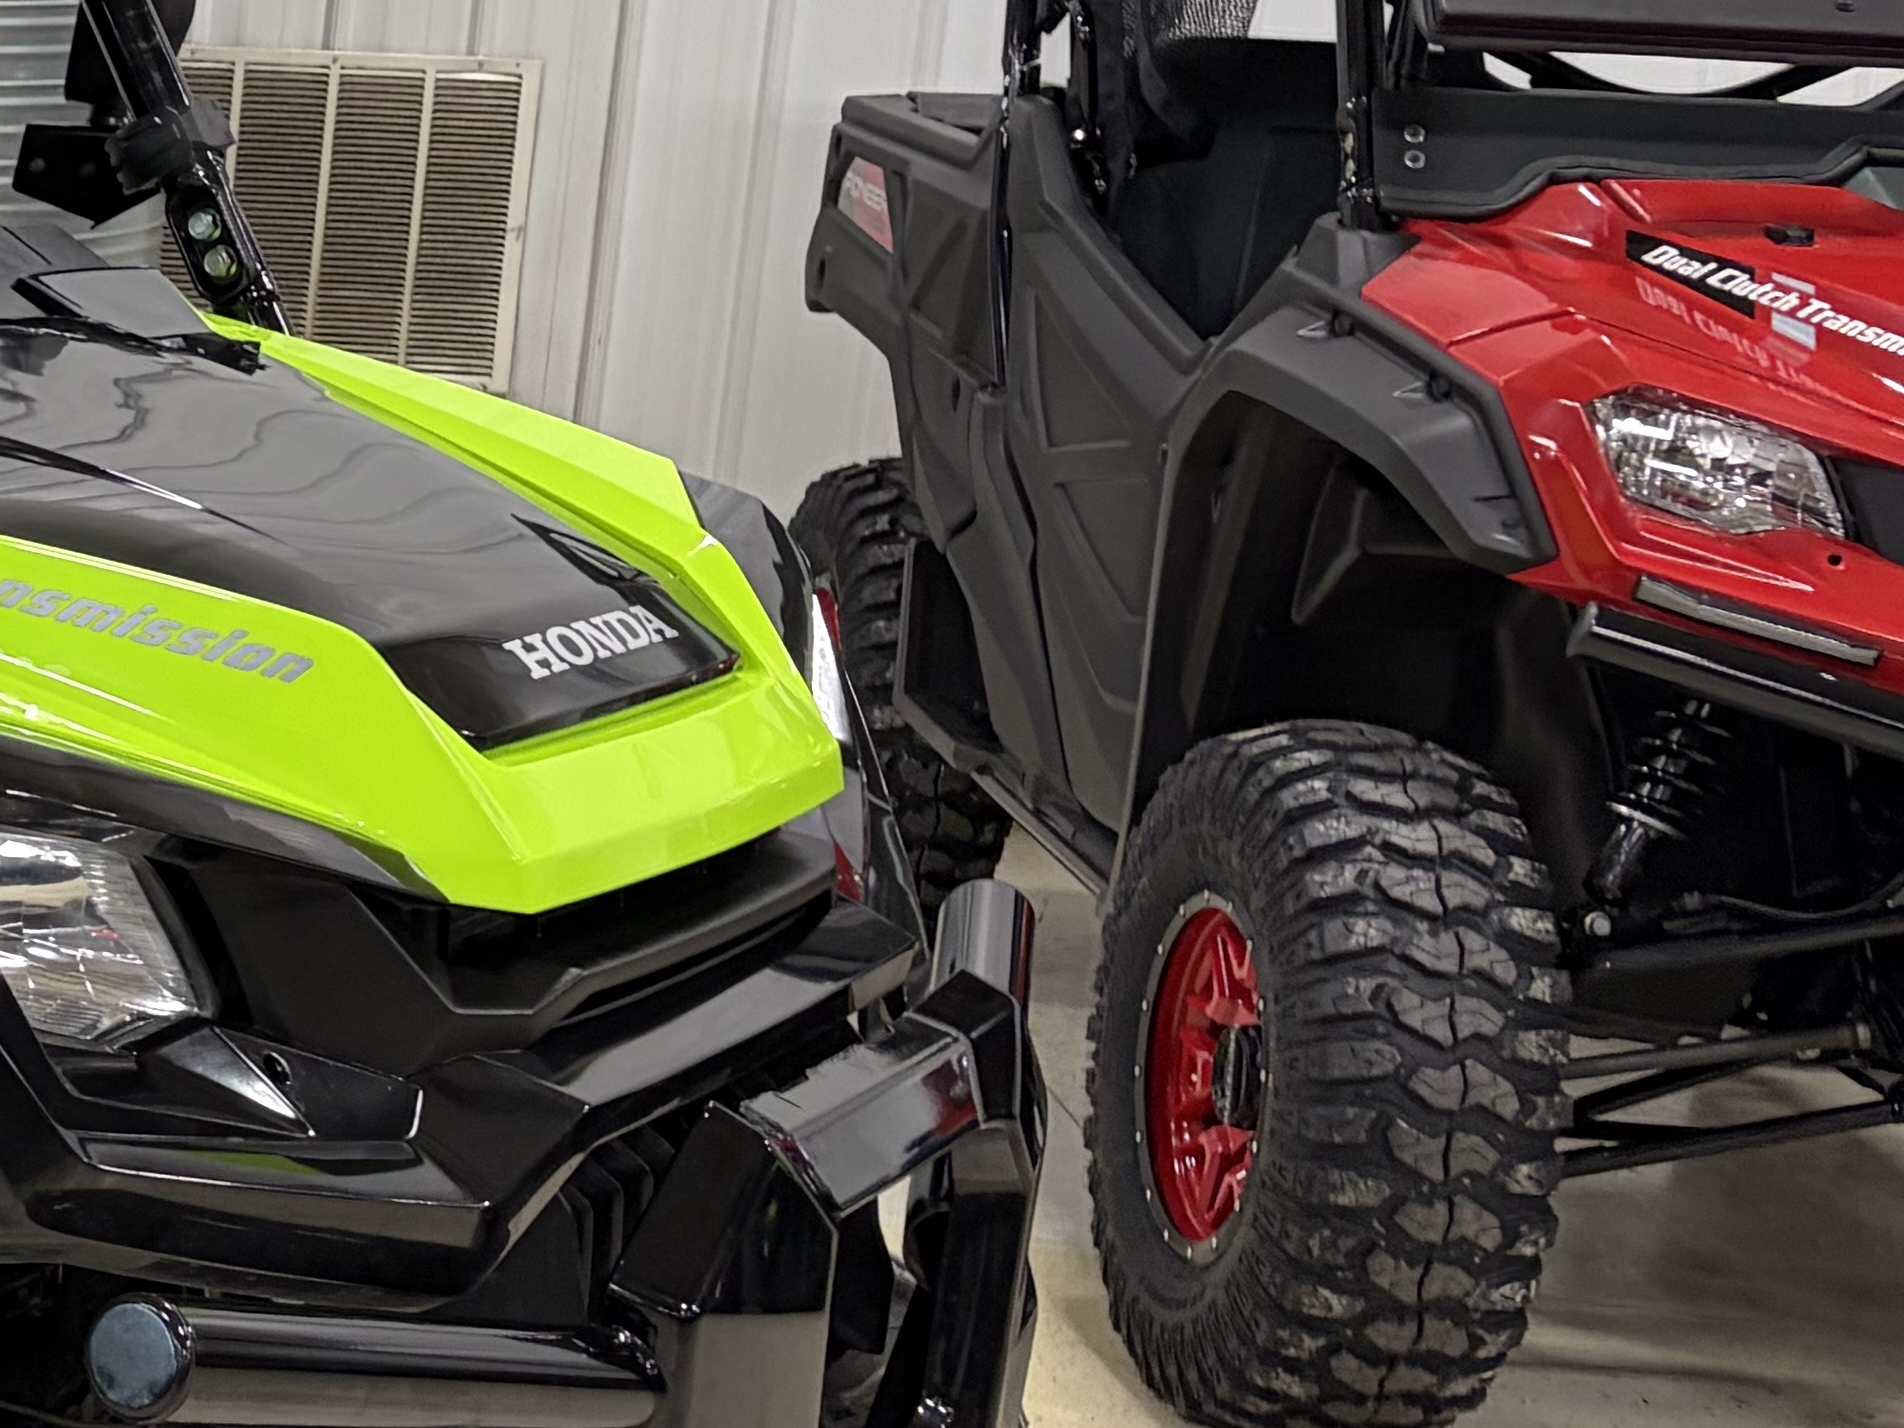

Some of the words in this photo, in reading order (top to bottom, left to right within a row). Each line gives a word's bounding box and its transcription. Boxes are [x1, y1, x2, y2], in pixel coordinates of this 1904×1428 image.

[1641, 244, 1718, 279] Dual
[1705, 267, 1800, 312] Clutch
[501, 604, 680, 680] HONDA
